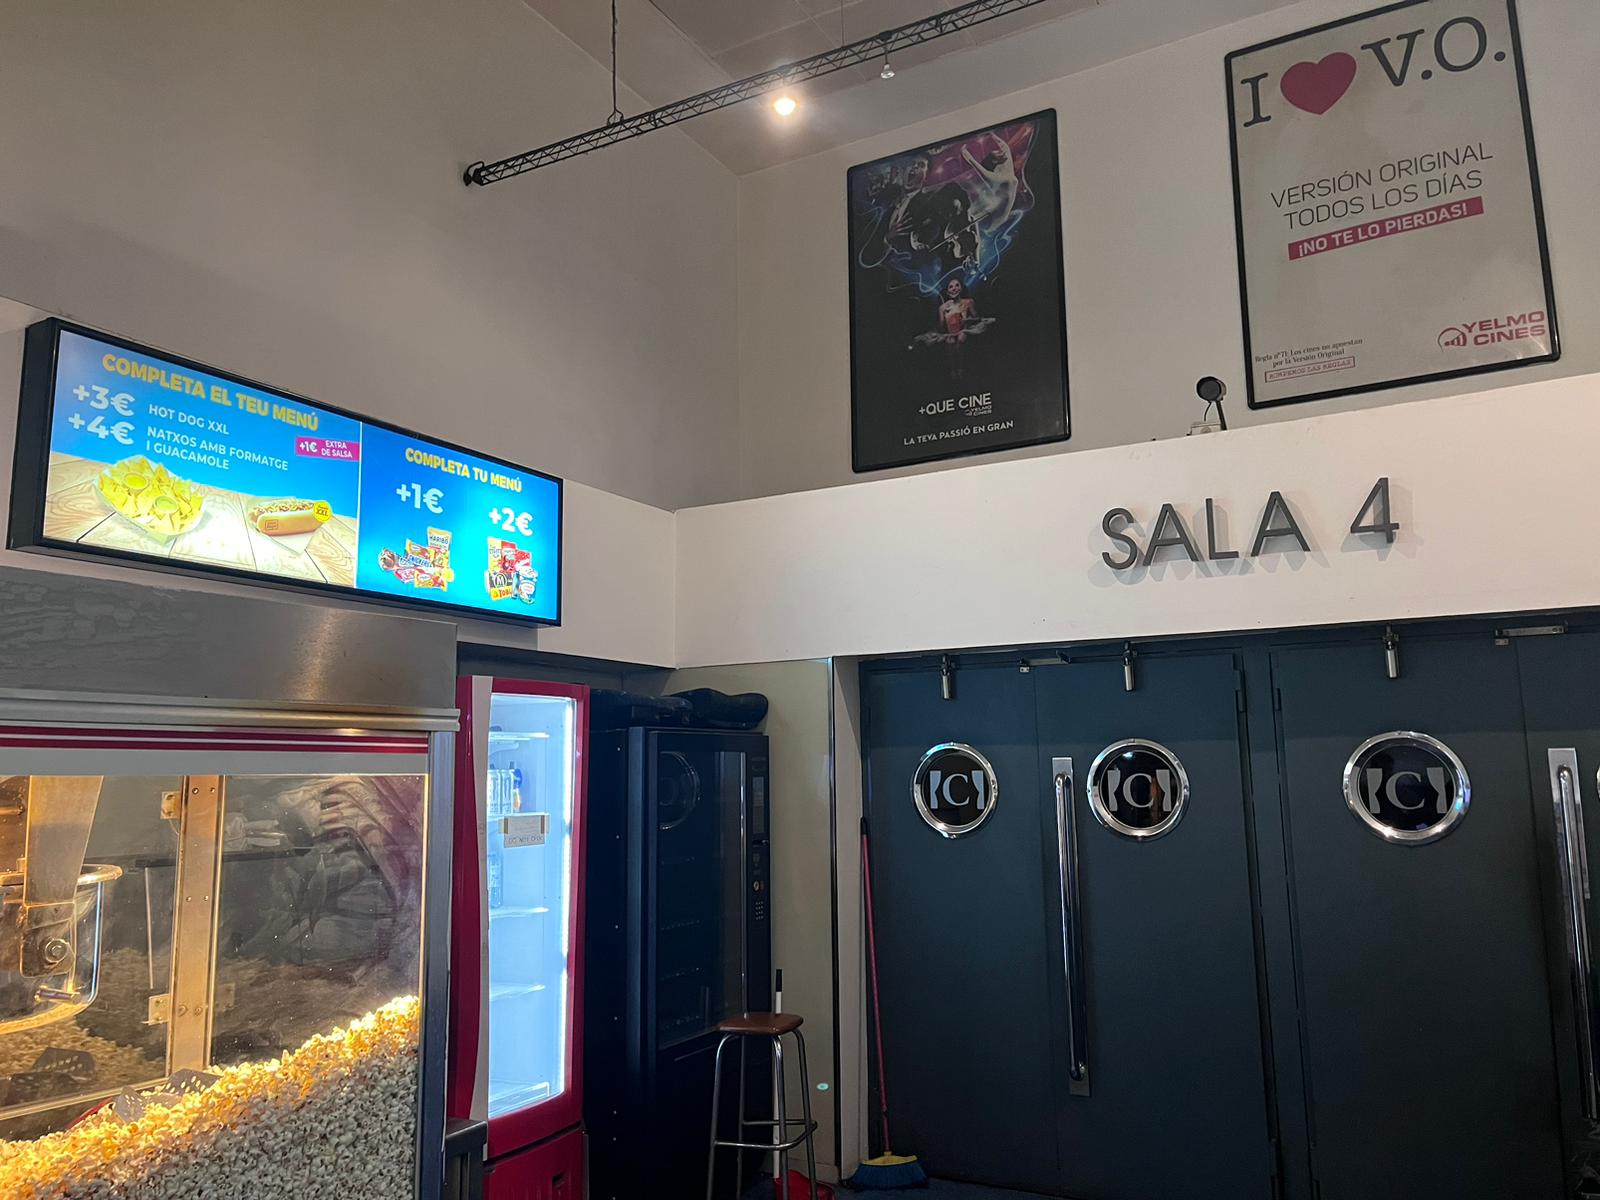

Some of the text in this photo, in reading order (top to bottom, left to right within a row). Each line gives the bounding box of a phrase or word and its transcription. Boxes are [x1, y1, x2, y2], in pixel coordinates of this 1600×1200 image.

[1240, 15, 1507, 128] I V.O.
[1270, 142, 1493, 209] VERSIÓN ORIGINAL
[1284, 169, 1483, 230] TODOS LOS DÍAS
[1298, 202, 1468, 257] ¡NO TE LO PIERDAS!
[1461, 310, 1545, 334] YELMO
[1472, 324, 1546, 346] CINES
[72, 384, 136, 417] +3€
[102, 353, 319, 432] COMPLETA EL TEU MENÚ
[958, 392, 993, 408] CINE
[67, 412, 136, 445] +4€
[148, 403, 230, 436] HOT DOG XXL
[903, 420, 1015, 446] LA TEVA PASSIÓ EN GRAN
[147, 425, 289, 471] NATXOS AMB FORMATGE
[153, 443, 230, 470] GUACAMOLE
[299, 440, 319, 453] +1€
[321, 448, 353, 459] DE SALSA
[325, 439, 348, 450] EXTRA
[404, 447, 523, 493] COMPLETA TU MENÚ
[396, 482, 445, 514] +1€
[488, 507, 534, 536] +2€
[1101, 477, 1400, 570] SALA 4
